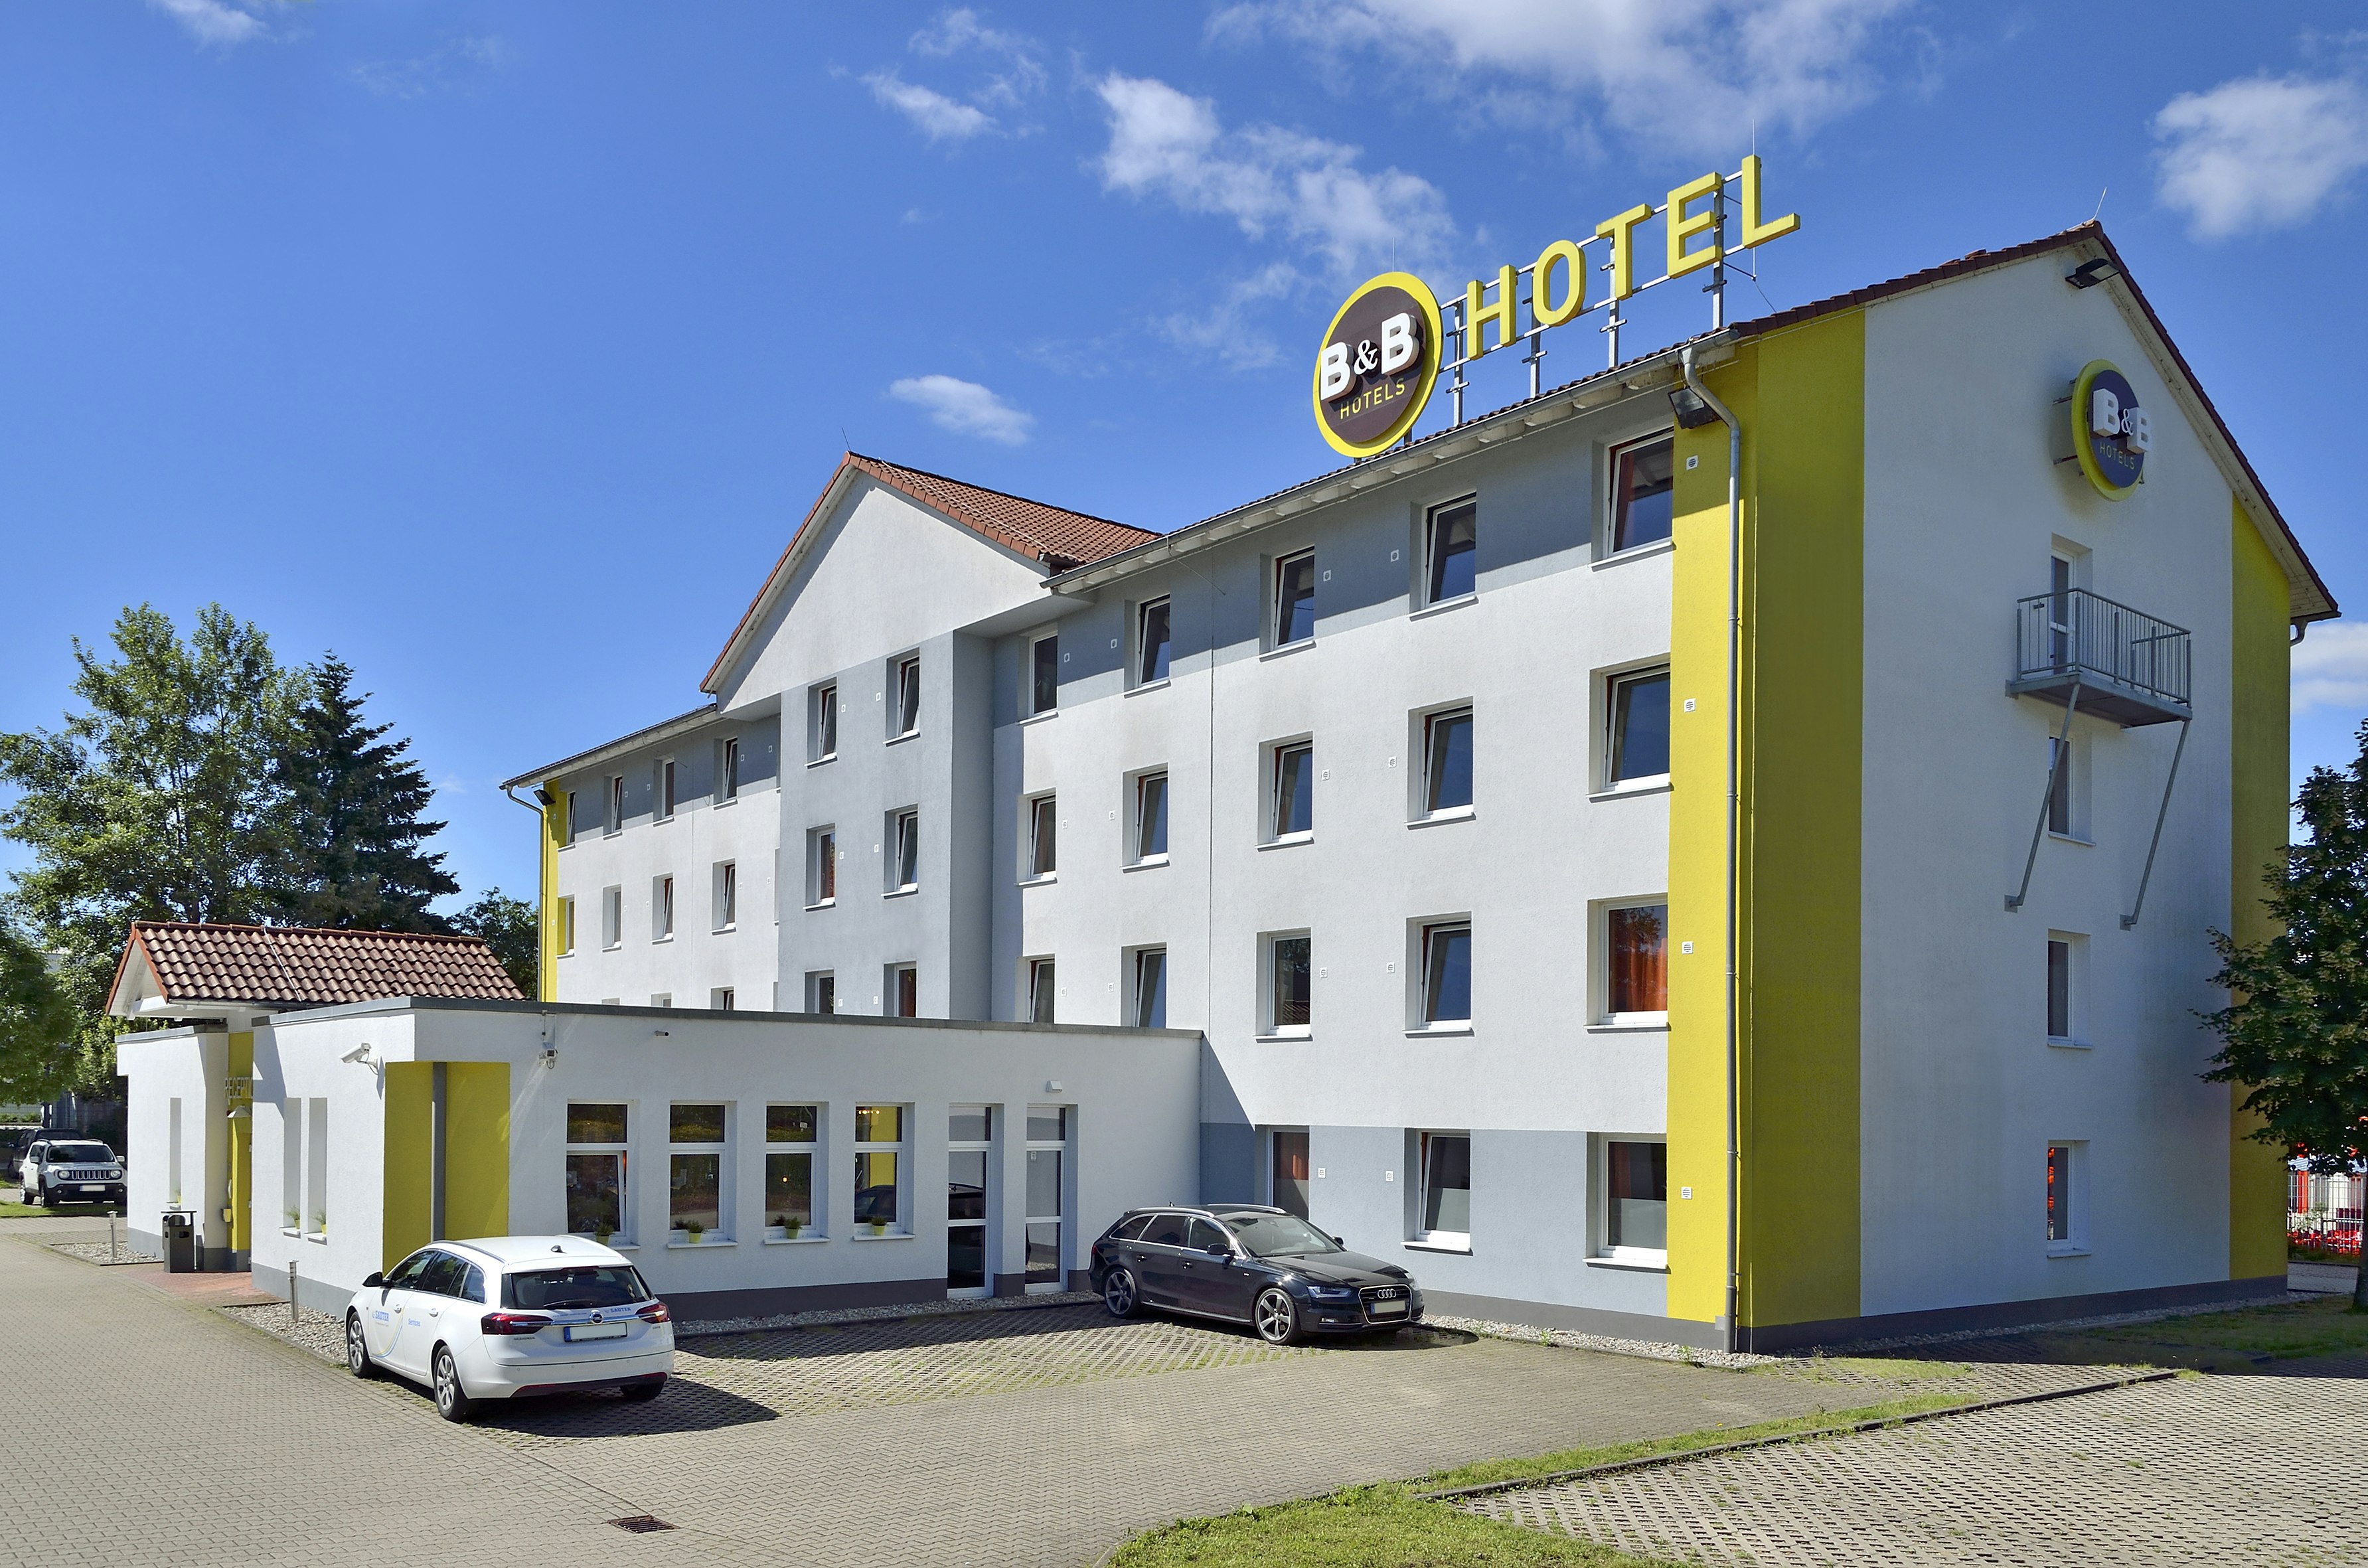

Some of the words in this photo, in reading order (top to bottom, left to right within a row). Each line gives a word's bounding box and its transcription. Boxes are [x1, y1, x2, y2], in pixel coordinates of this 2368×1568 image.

[1466, 155, 1800, 360] HOTEL
[1320, 313, 1419, 401] B&B
[1340, 378, 1405, 420] HOTELS
[2092, 388, 2151, 454] B&B
[2100, 441, 2135, 470] HOTELS
